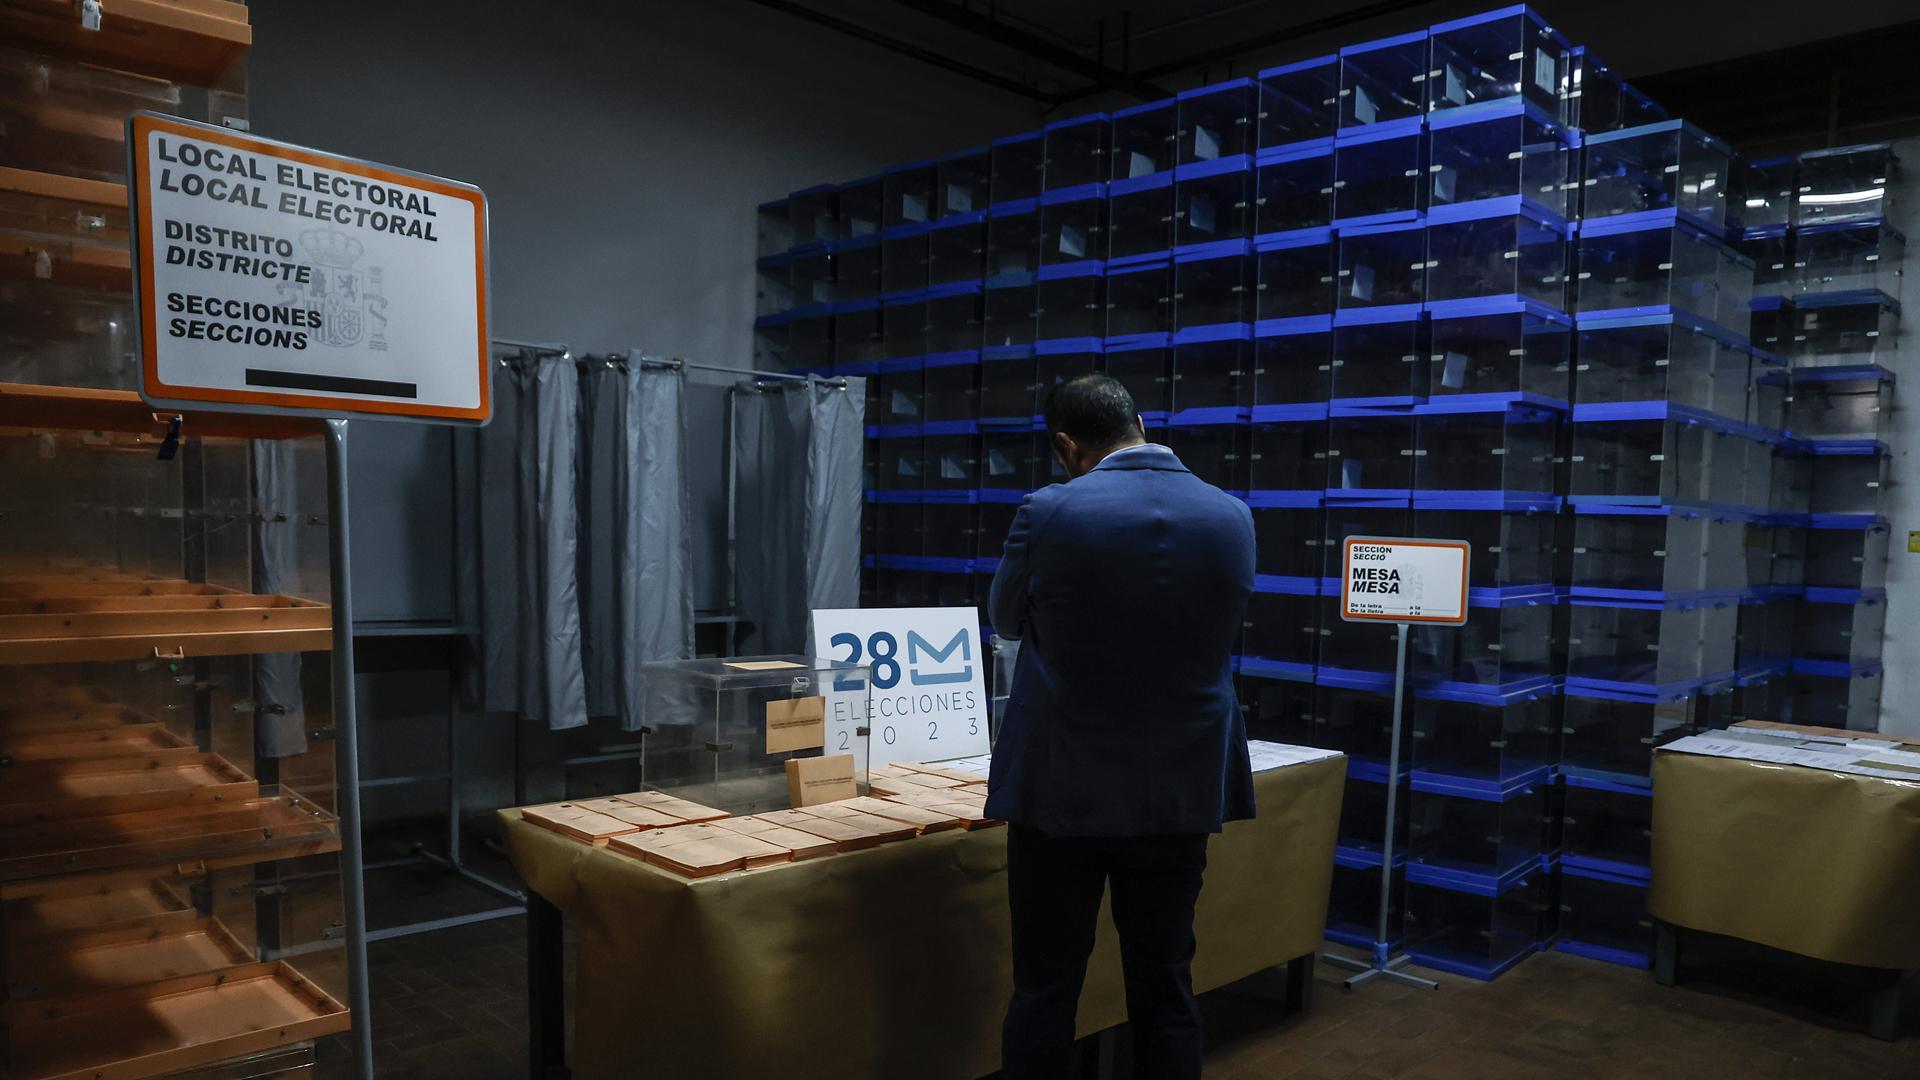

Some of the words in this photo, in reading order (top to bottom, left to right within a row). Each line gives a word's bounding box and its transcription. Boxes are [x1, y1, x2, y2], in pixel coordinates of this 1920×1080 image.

[158, 138, 266, 181] LOCAL
[277, 163, 437, 217] ELECTORAL
[160, 168, 268, 210] LOCAL
[278, 192, 438, 242] ELECTORAL
[165, 219, 293, 257] DISTRITO
[166, 245, 311, 284] DISTRICTE
[167, 293, 322, 329] SECCIONES
[168, 318, 308, 350] SECCIONS
[1352, 581, 1399, 594] MESA
[1353, 568, 1400, 581] MESA
[834, 690, 976, 722] ELECCIONES
